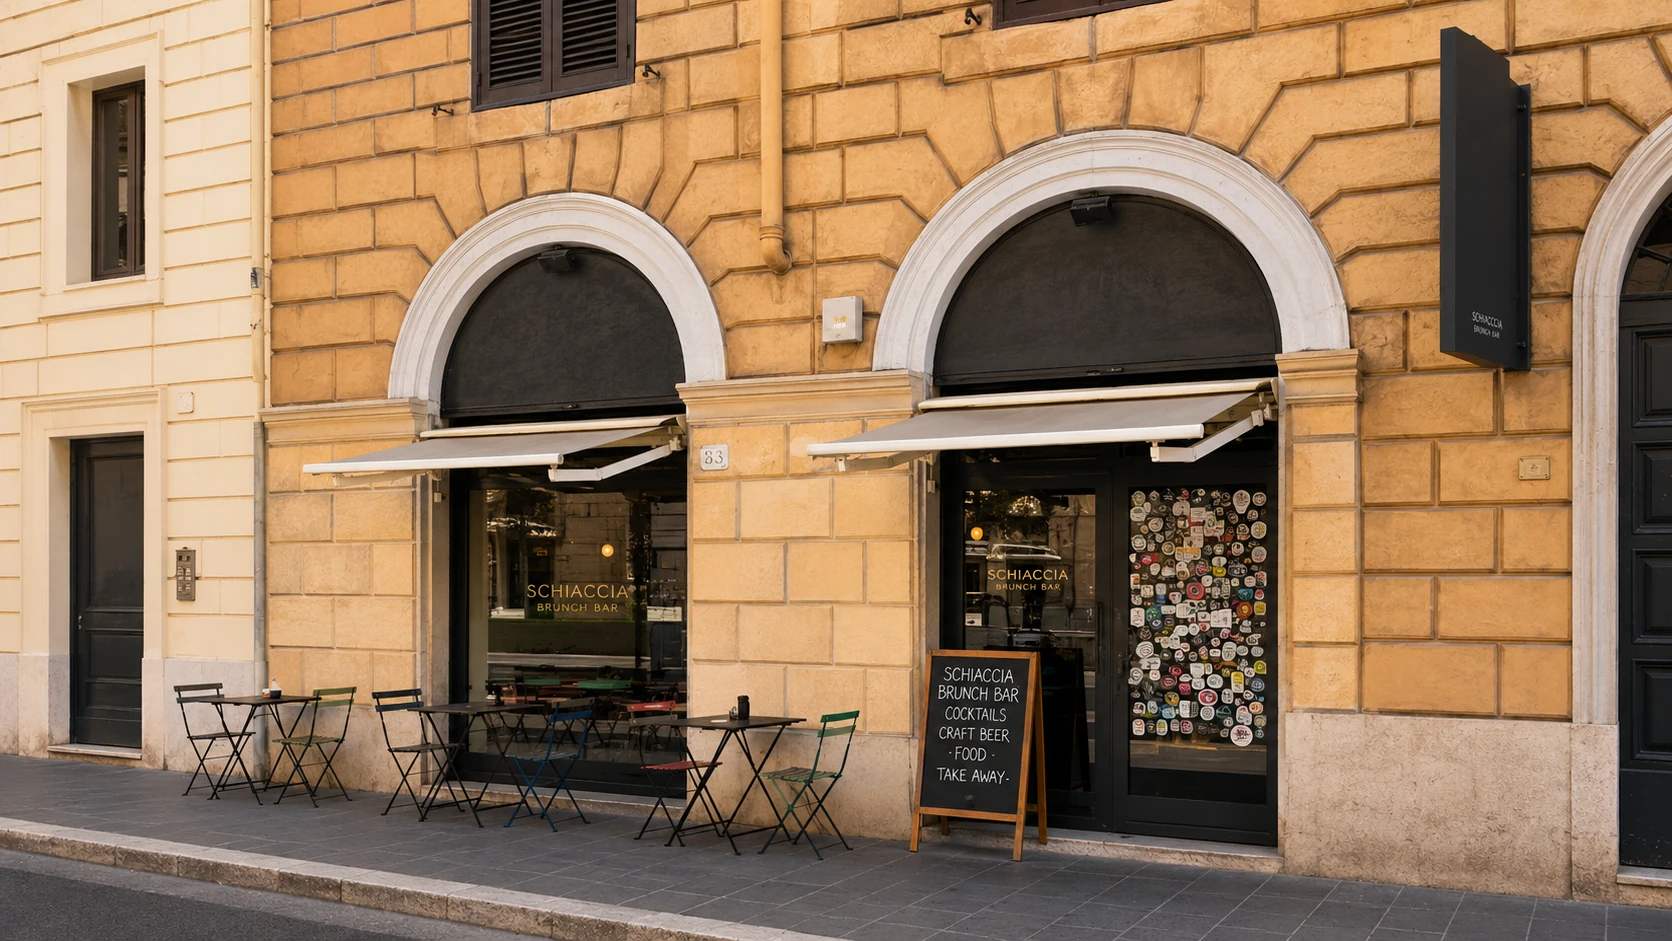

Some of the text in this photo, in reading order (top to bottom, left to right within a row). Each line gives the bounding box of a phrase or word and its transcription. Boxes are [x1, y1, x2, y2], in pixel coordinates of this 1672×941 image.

[987, 569, 1068, 581] SCHIACCIA
[526, 584, 629, 599] SCHIACCIA
[995, 583, 1061, 591] BRUNCH BAR
[536, 603, 618, 613] BRUNCH BAR
[943, 666, 1014, 684] SCHIACCIA
[937, 684, 1020, 703] BRUNCH BAR
[944, 705, 1007, 722] COCKTAILS
[938, 726, 1010, 743] CRAFT BEER
[954, 745, 987, 762] FOOD
[936, 767, 967, 782] TAKE
